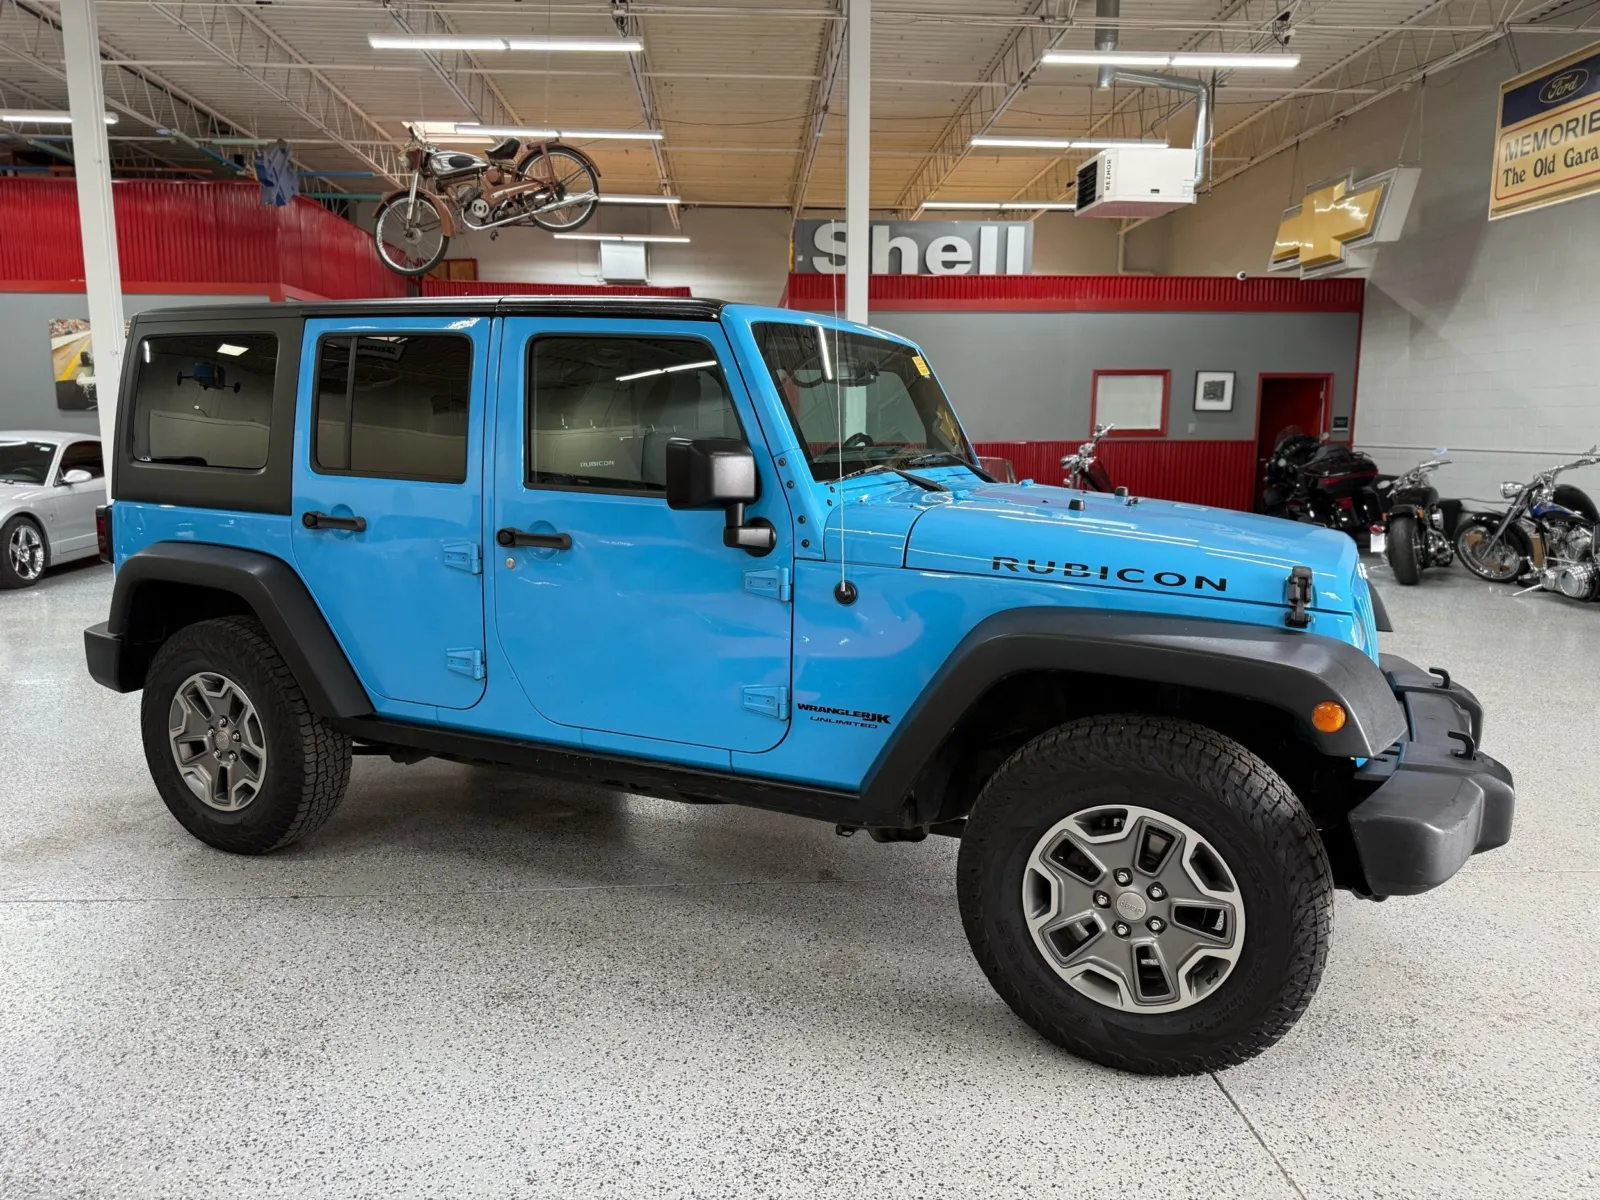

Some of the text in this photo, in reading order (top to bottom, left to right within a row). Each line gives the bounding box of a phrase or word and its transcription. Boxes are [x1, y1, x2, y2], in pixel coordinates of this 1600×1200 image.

[1548, 74, 1579, 100] Ford
[1504, 110, 1600, 163] MEMORIE
[1503, 167, 1526, 188] The
[1533, 154, 1556, 178] Old
[812, 222, 1026, 275] Shell
[580, 460, 615, 468] RUBICON
[992, 556, 1227, 592] RUBICON
[810, 715, 878, 729] UNLIMITED
